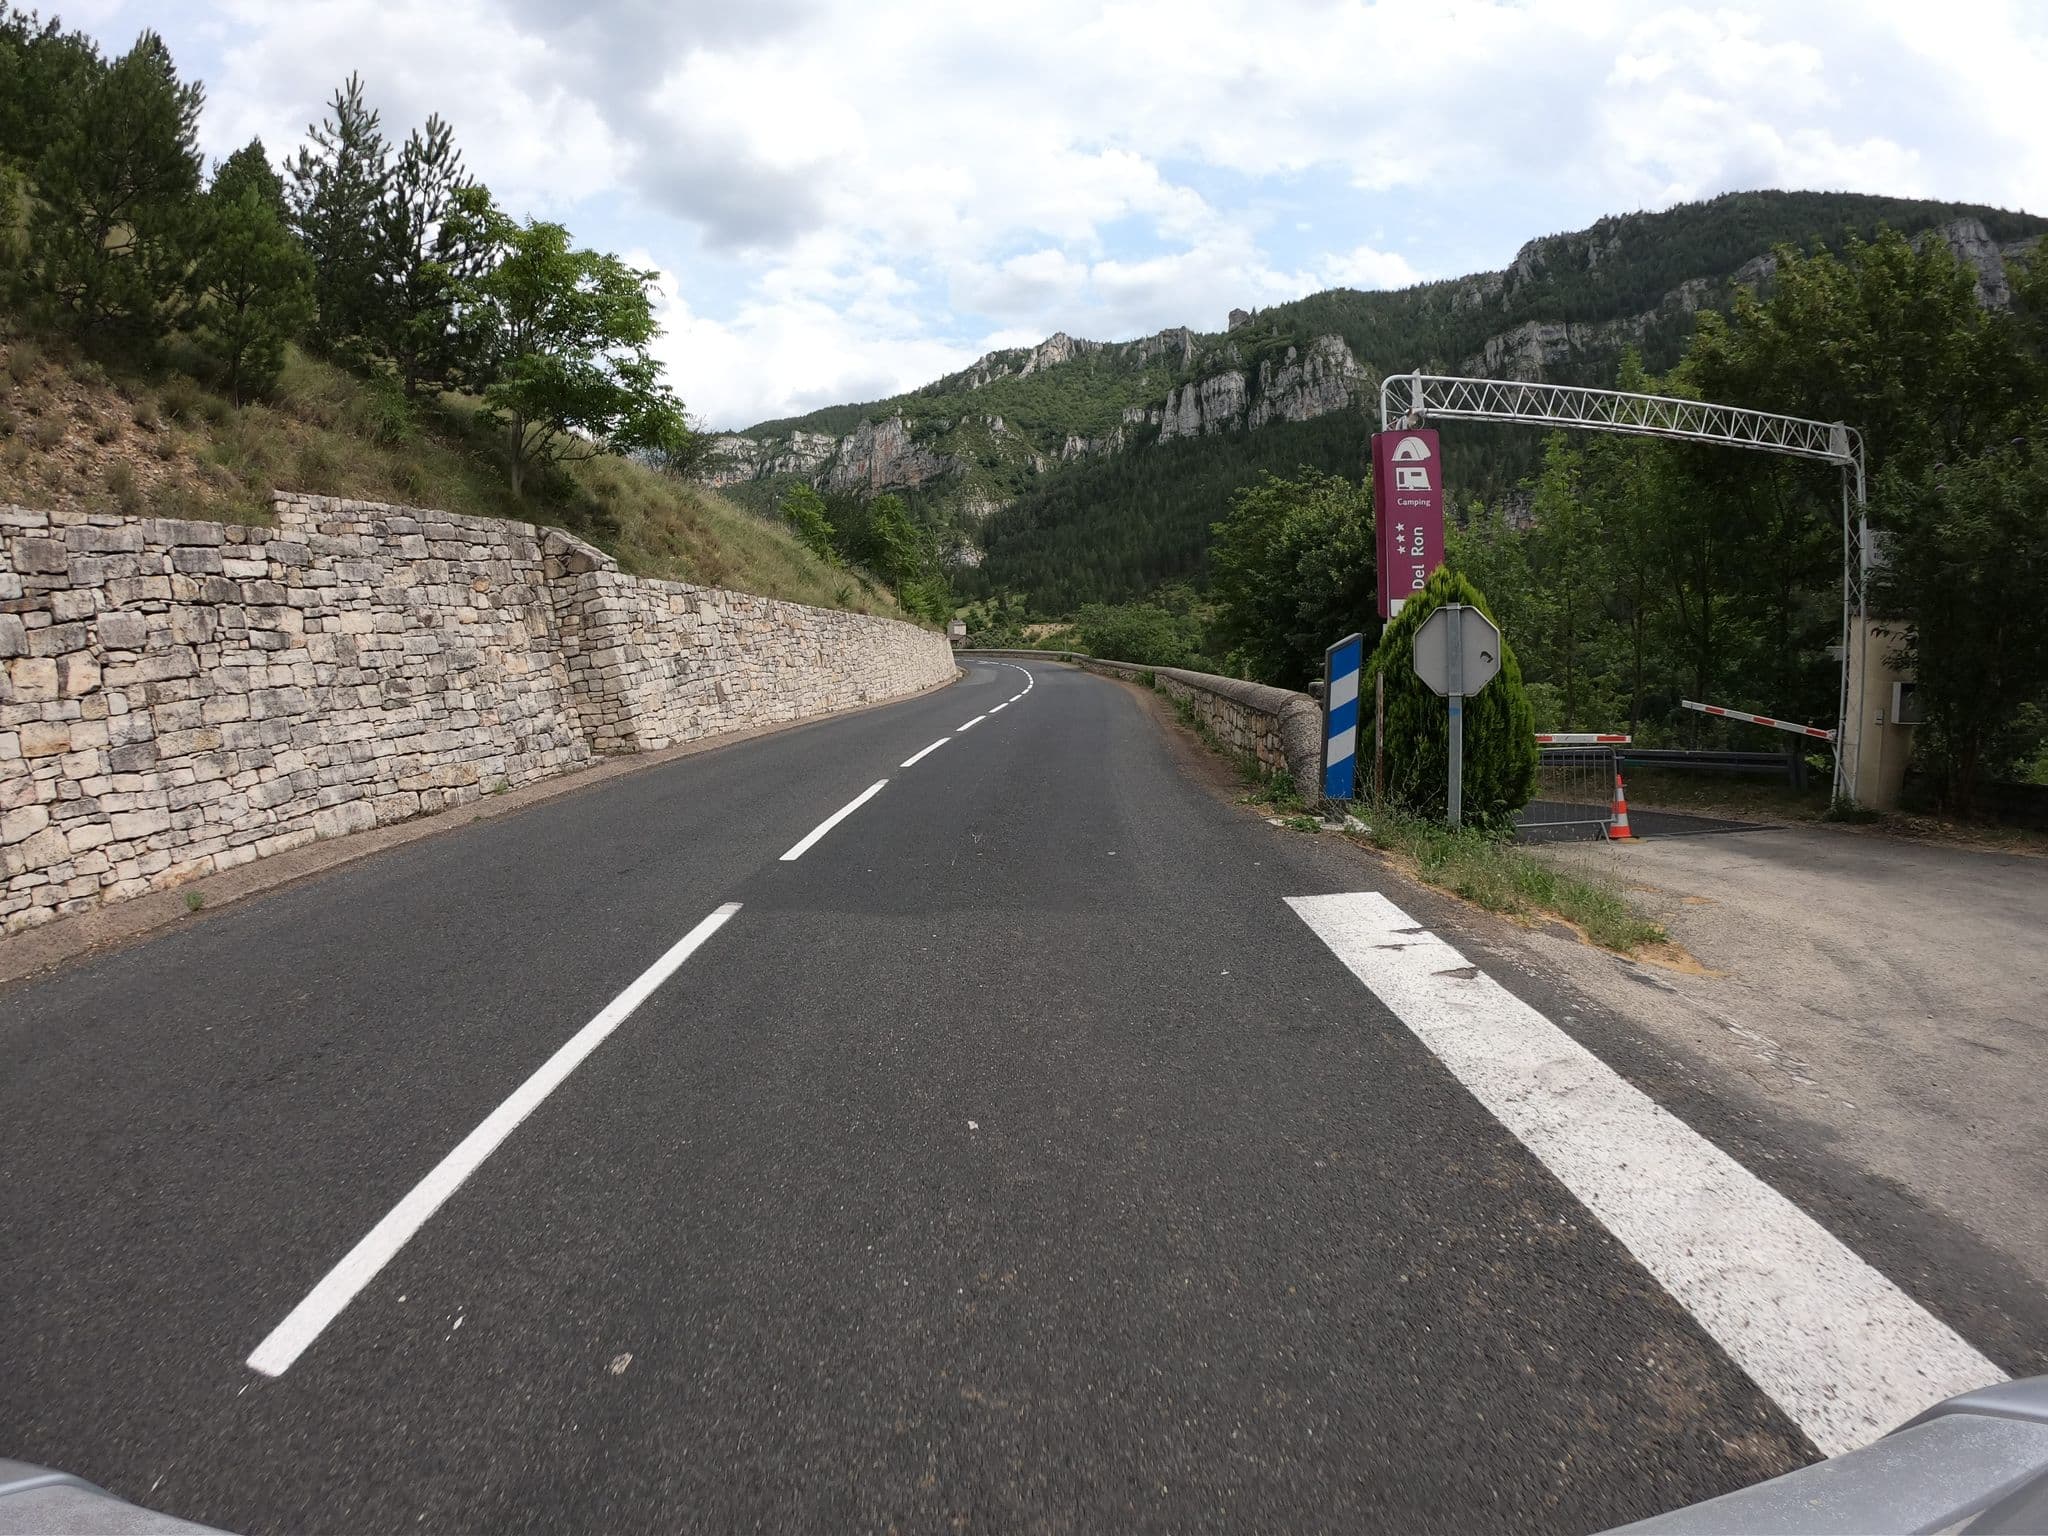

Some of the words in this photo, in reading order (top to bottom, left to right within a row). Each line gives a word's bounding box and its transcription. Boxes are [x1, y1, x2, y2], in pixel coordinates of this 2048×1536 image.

[1397, 498, 1431, 507] Camping
[1411, 527, 1425, 556] Ron
[1412, 564, 1425, 589] Del
